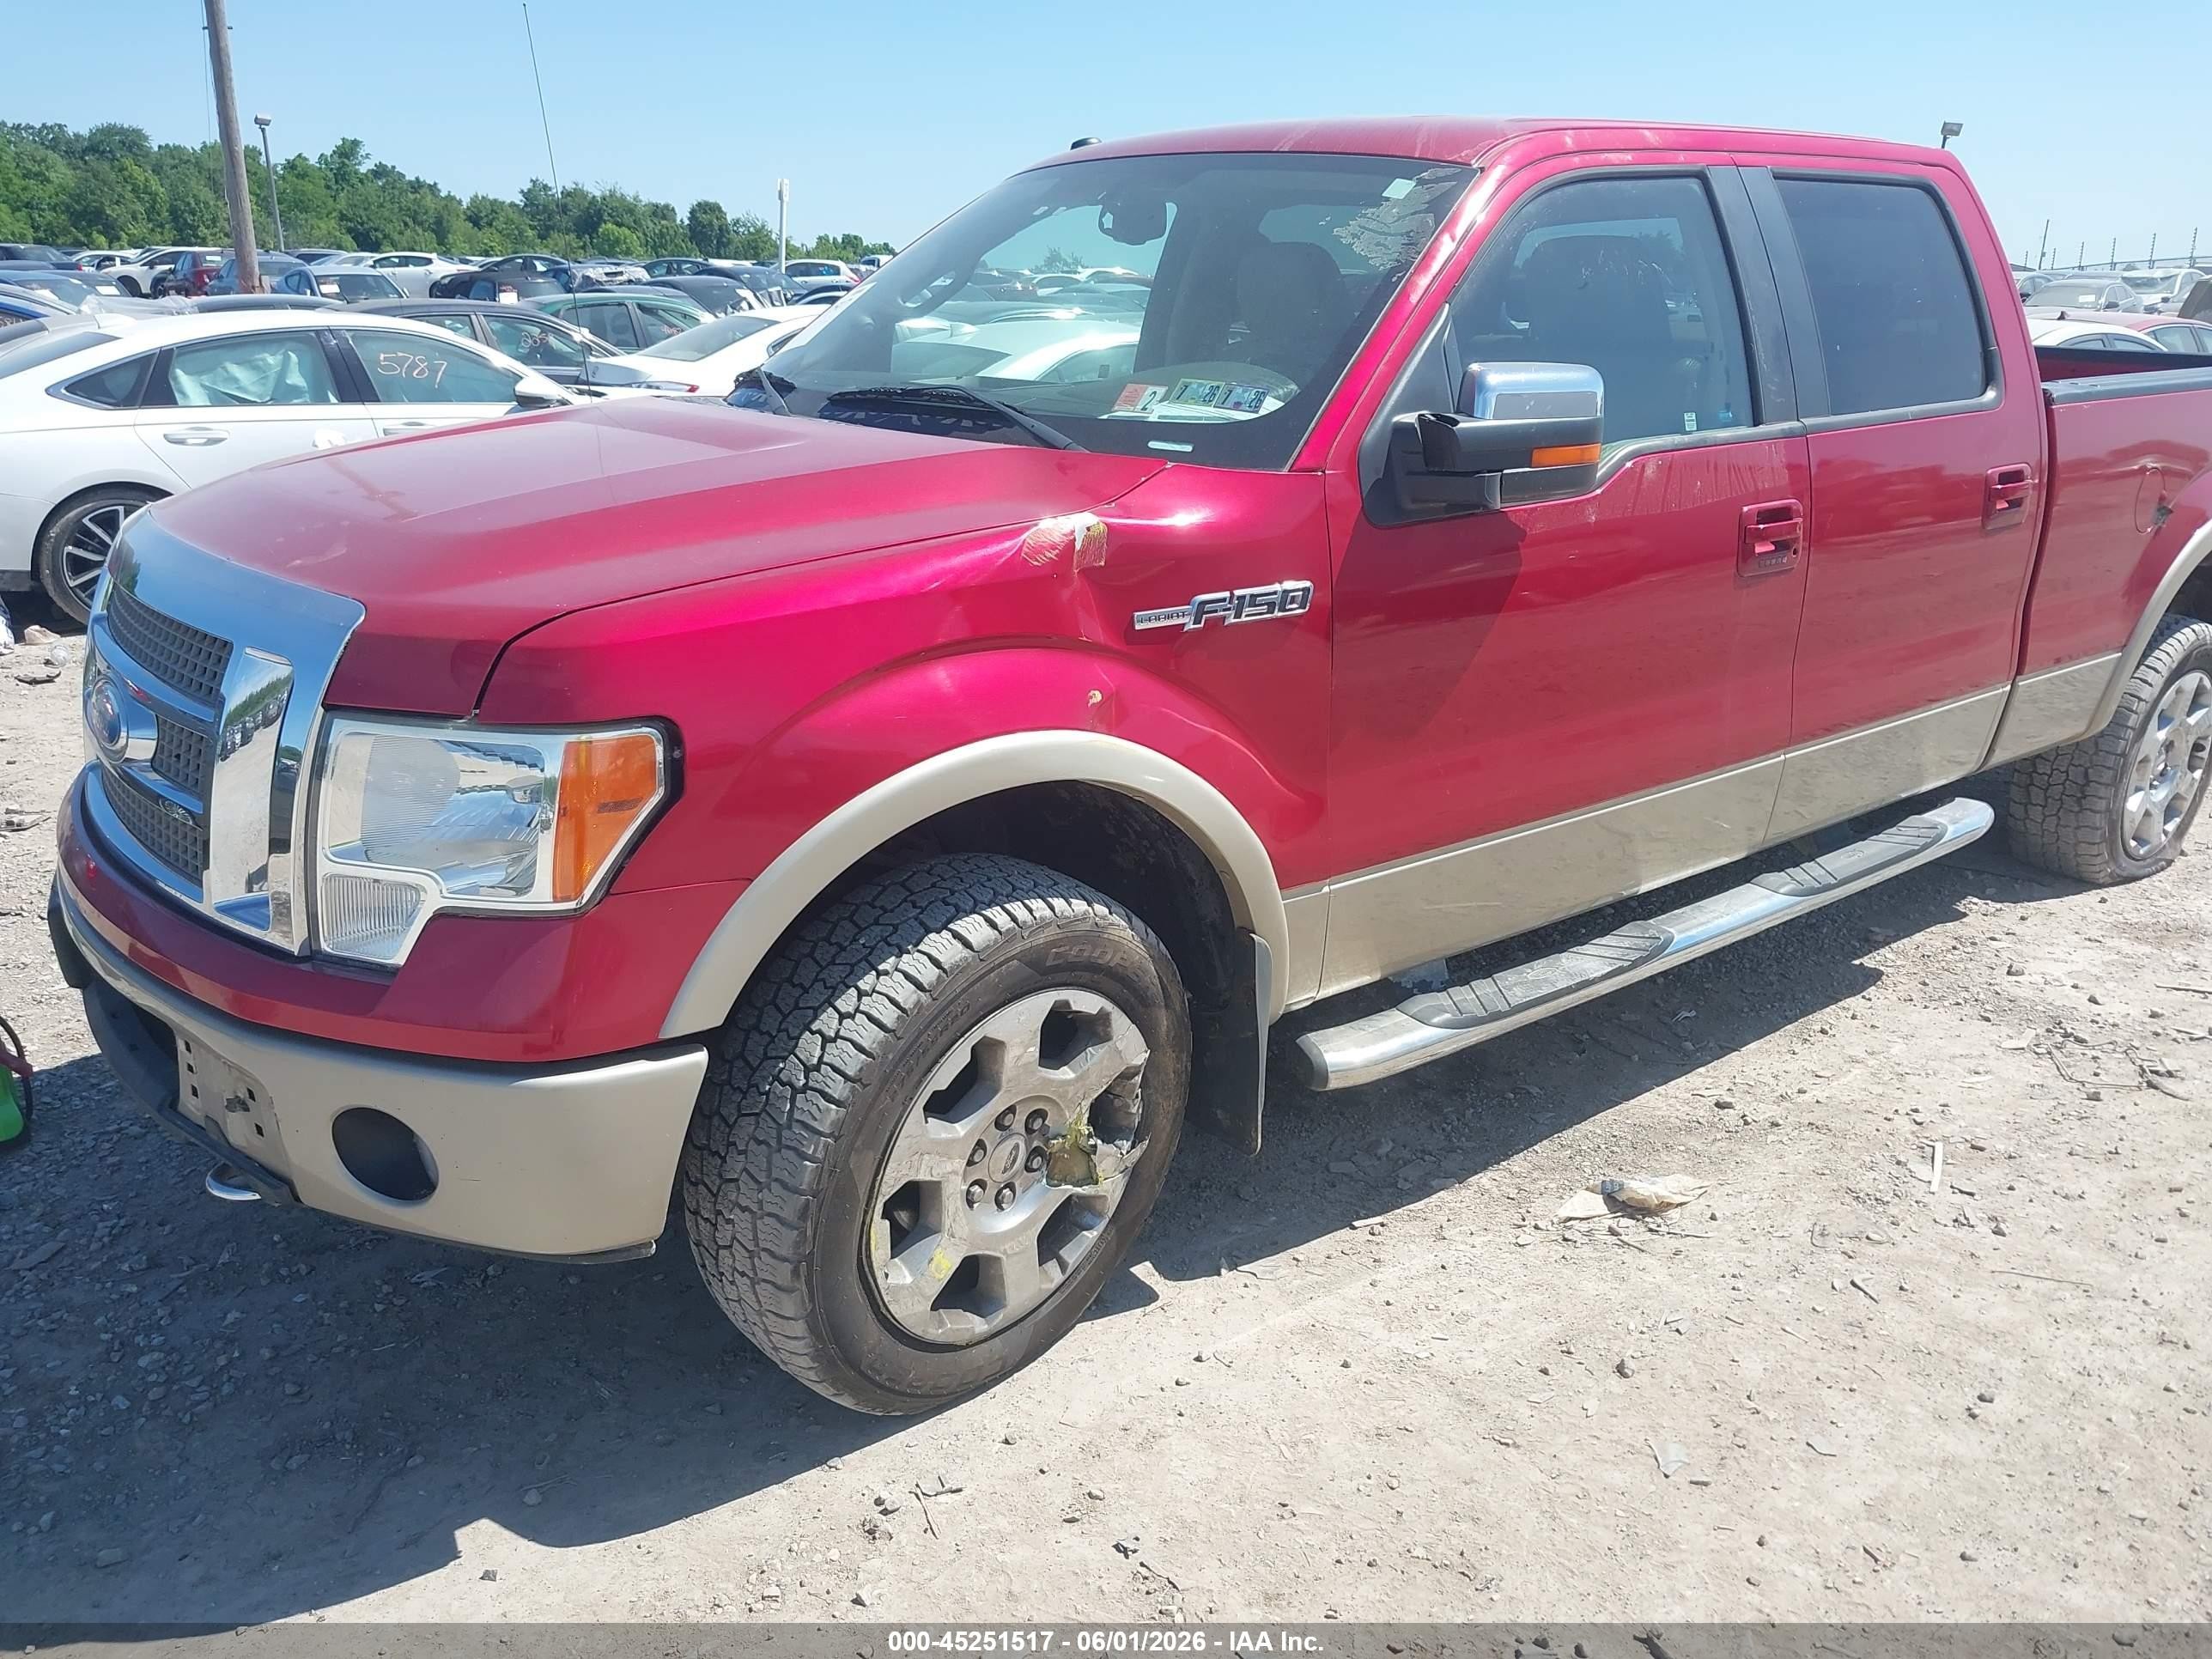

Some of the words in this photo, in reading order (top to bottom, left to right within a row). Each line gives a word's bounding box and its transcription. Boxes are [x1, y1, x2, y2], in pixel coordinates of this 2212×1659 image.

[378, 351, 447, 388] 5787
[1140, 391, 1157, 410] 2
[1176, 385, 1188, 400] 7
[1202, 385, 1220, 403] 26
[1221, 389, 1233, 405] 7
[1248, 390, 1266, 409] 26
[1188, 582, 1313, 629] F-150
